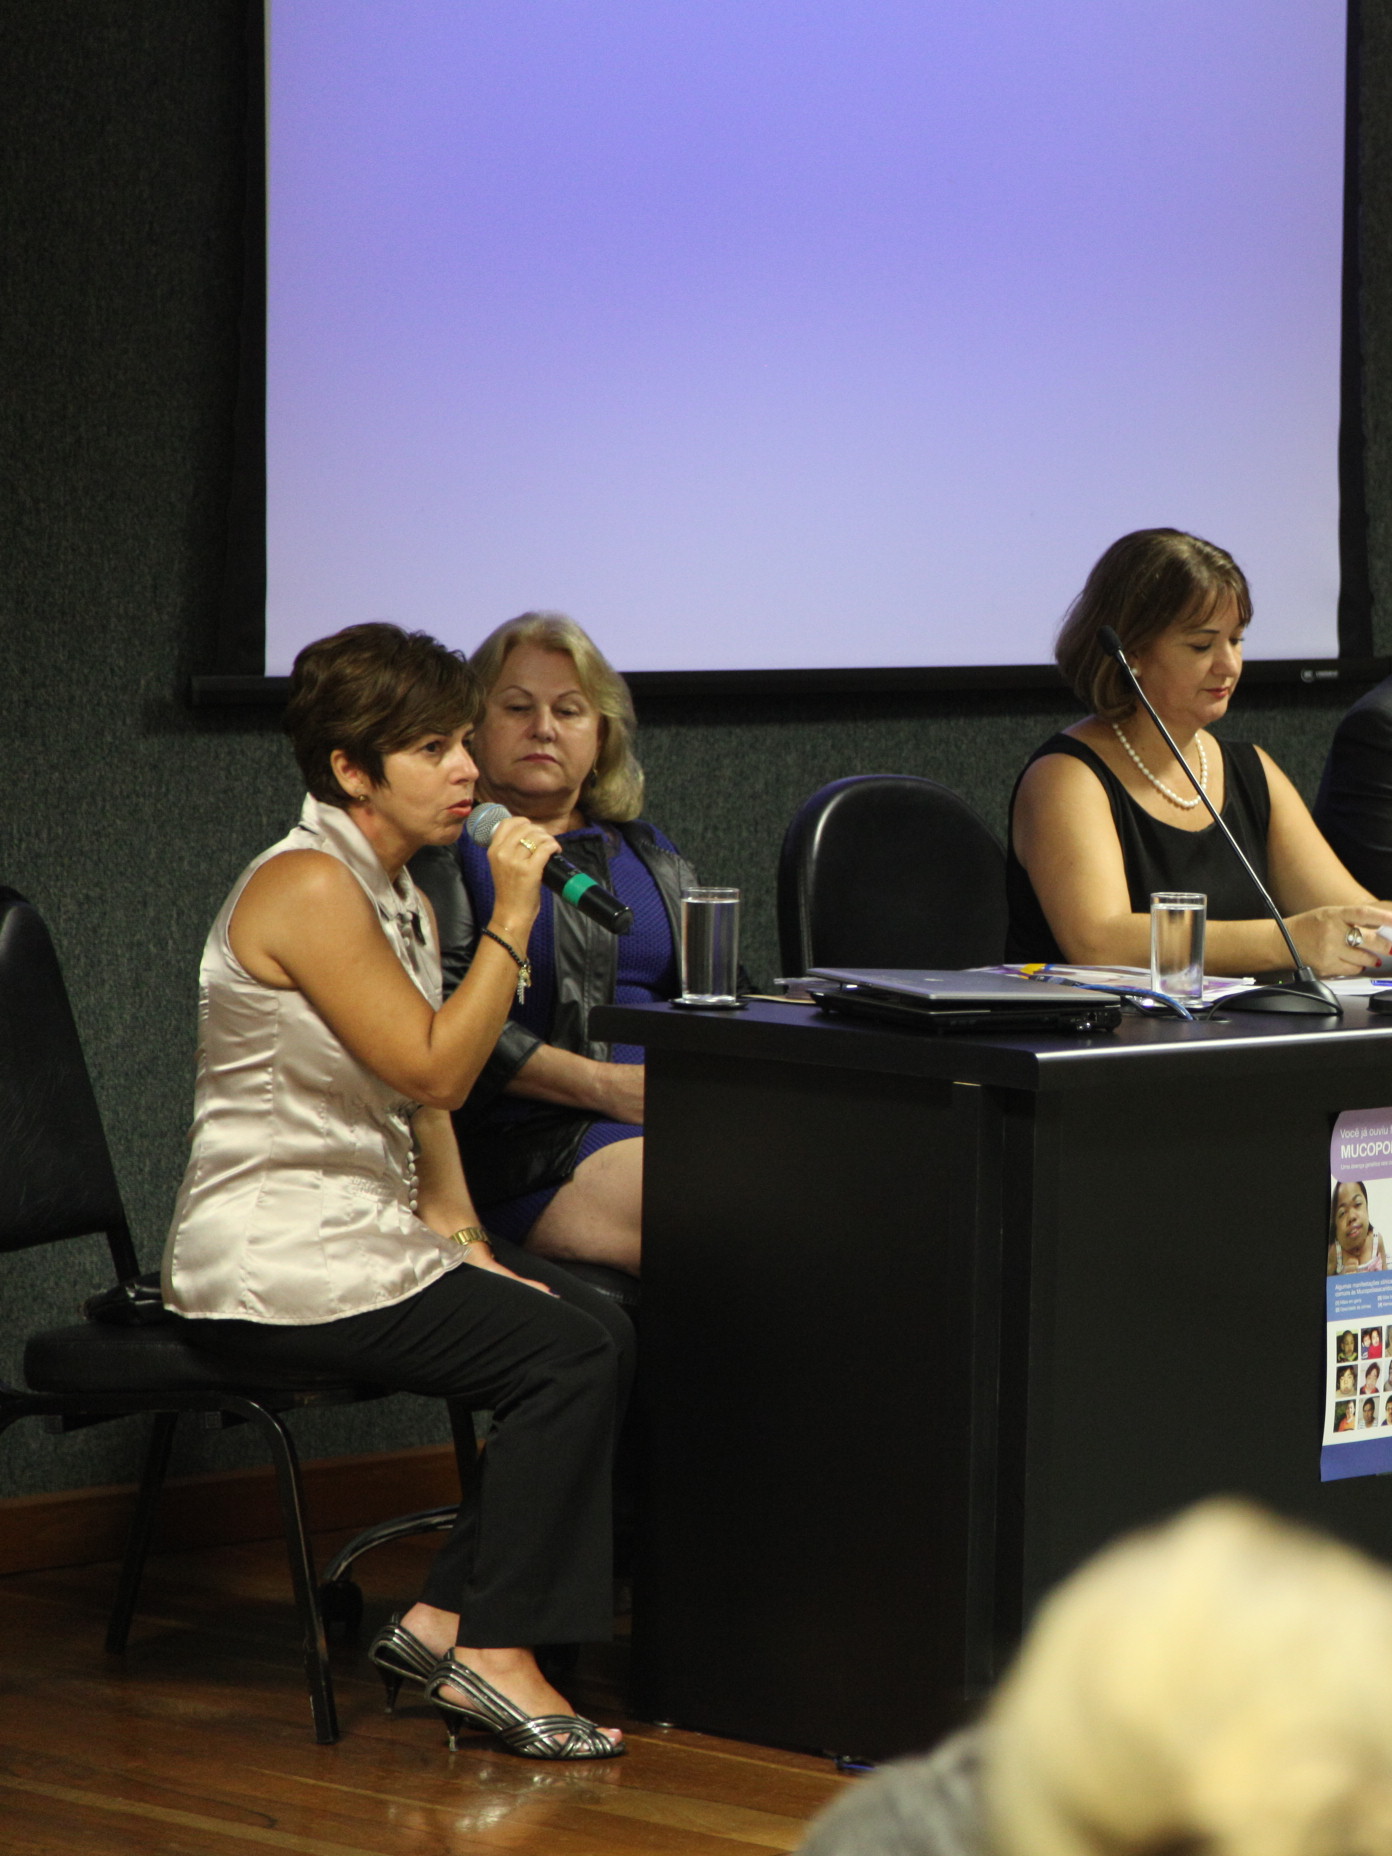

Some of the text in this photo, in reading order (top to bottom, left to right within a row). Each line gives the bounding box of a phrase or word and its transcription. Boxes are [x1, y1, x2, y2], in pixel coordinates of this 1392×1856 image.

[1340, 1129, 1359, 1138] Você
[1361, 1128, 1367, 1139] já
[1369, 1126, 1388, 1136] ouviu
